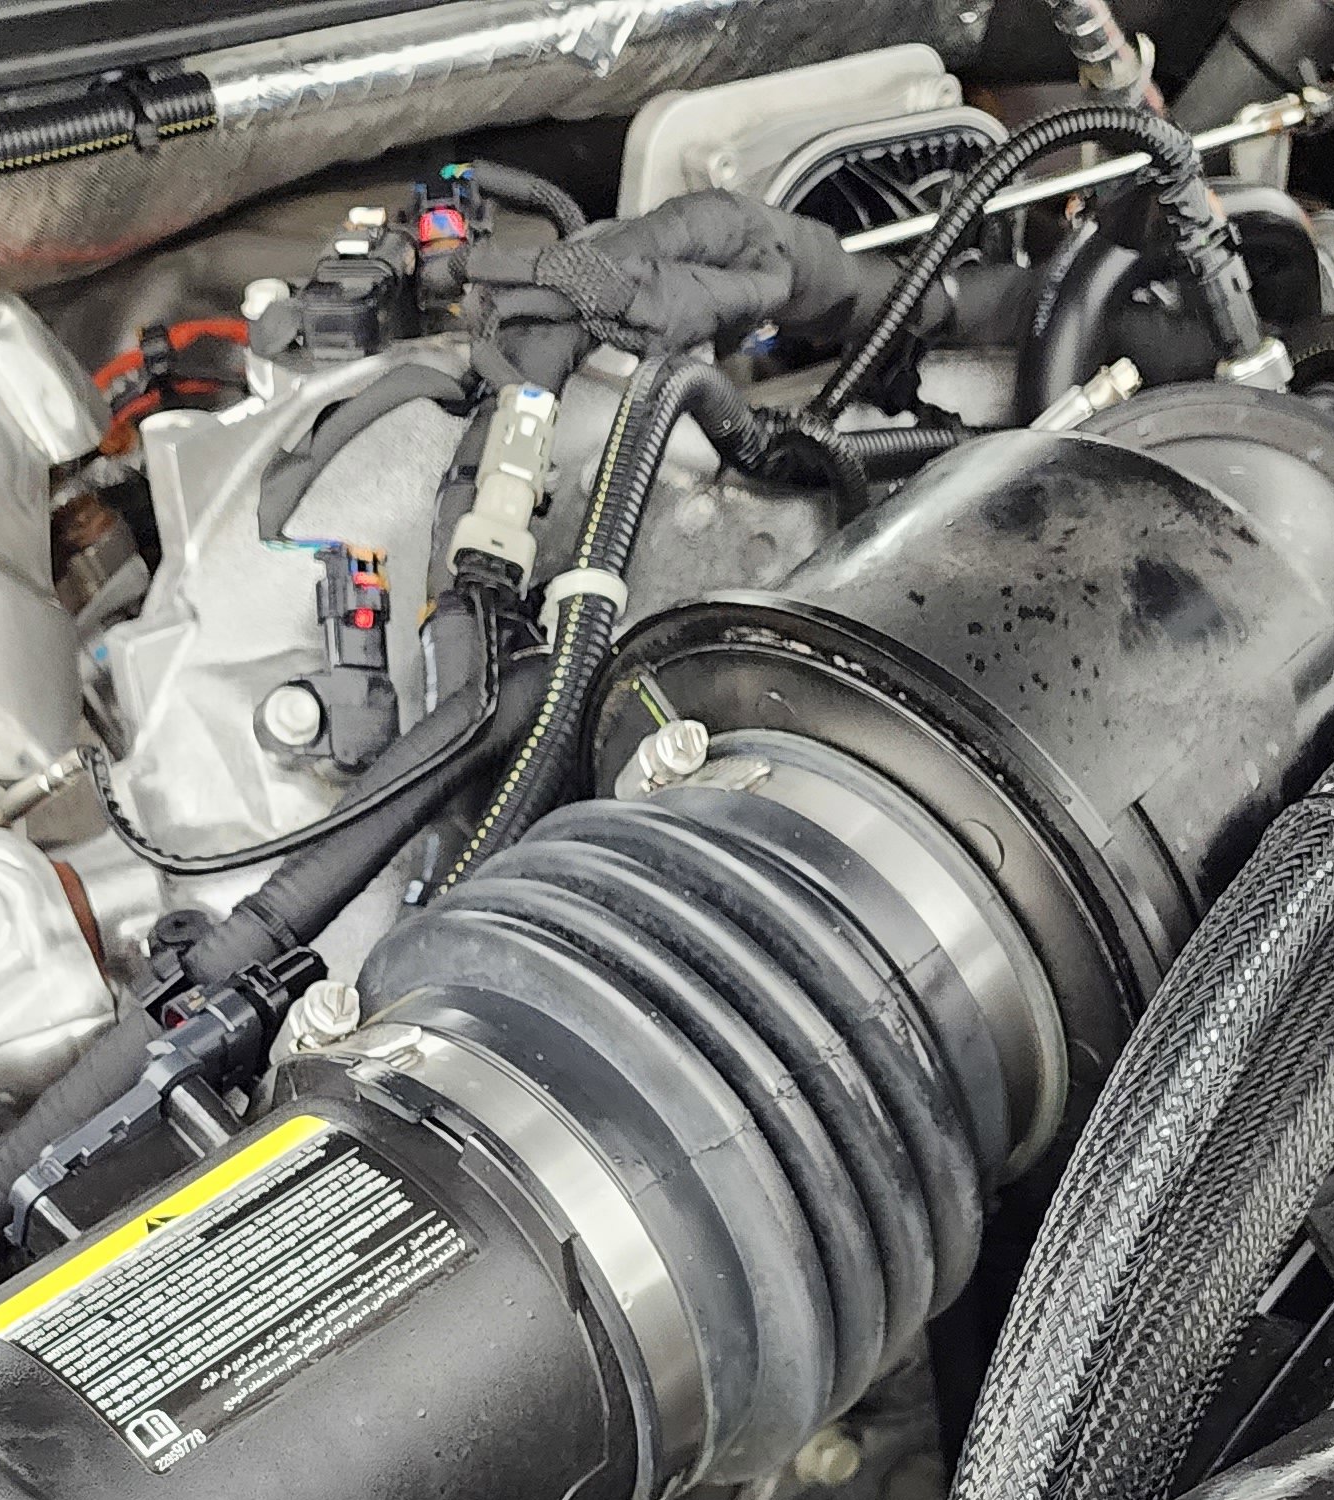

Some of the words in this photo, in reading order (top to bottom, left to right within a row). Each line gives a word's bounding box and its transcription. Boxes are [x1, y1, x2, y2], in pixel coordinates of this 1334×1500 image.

[337, 1173, 353, 1185] 12
[386, 1264, 402, 1279] 12
[111, 1275, 127, 1286] 12
[165, 1351, 182, 1365] 12
